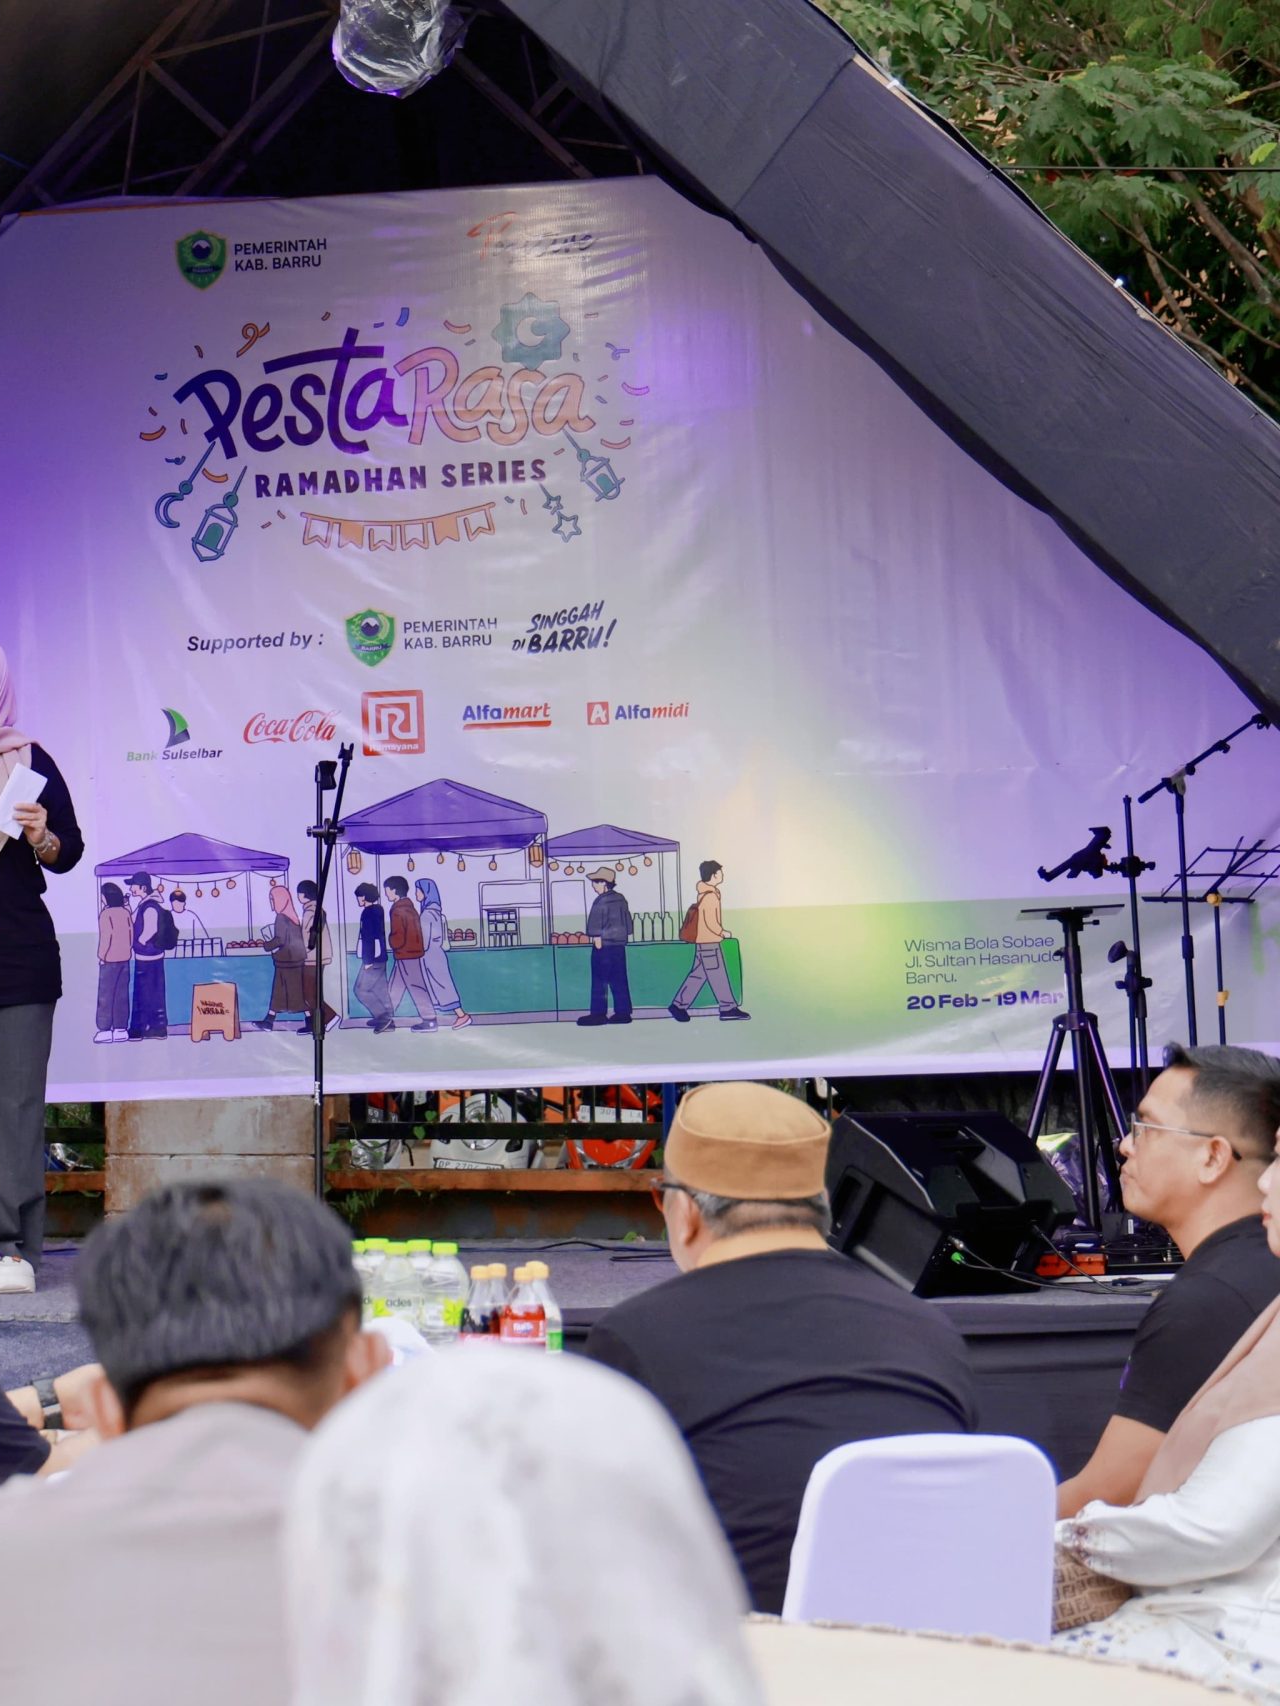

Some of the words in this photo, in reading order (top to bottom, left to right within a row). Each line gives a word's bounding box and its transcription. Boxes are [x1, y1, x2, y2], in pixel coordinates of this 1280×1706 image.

[234, 238, 327, 256] PEMERINTAH
[235, 259, 268, 272] KAB.
[272, 255, 322, 270] BARRU
[255, 465, 428, 498] RAMADHAN
[441, 459, 547, 487] SERIES
[403, 618, 498, 634] PEMERINTAH
[526, 600, 605, 634] SINGGAH
[187, 632, 285, 655] Supported
[289, 631, 313, 650] by
[404, 637, 438, 650] KAB.
[442, 634, 492, 648] BARRU
[512, 638, 526, 651] DI
[527, 618, 617, 655] BARRU!
[462, 702, 551, 721] Alfamart
[614, 702, 690, 720] Alfamidi
[126, 751, 158, 762] Bank
[162, 747, 223, 760] Sulselbar
[904, 938, 961, 952] Wisma
[964, 936, 999, 950] Bola
[1002, 935, 1055, 949] Sobae
[925, 953, 976, 968] Sultan
[906, 971, 957, 984] Barru.
[907, 995, 936, 1010] 20
[938, 993, 978, 1008] Feb
[995, 991, 1017, 1006] 19
